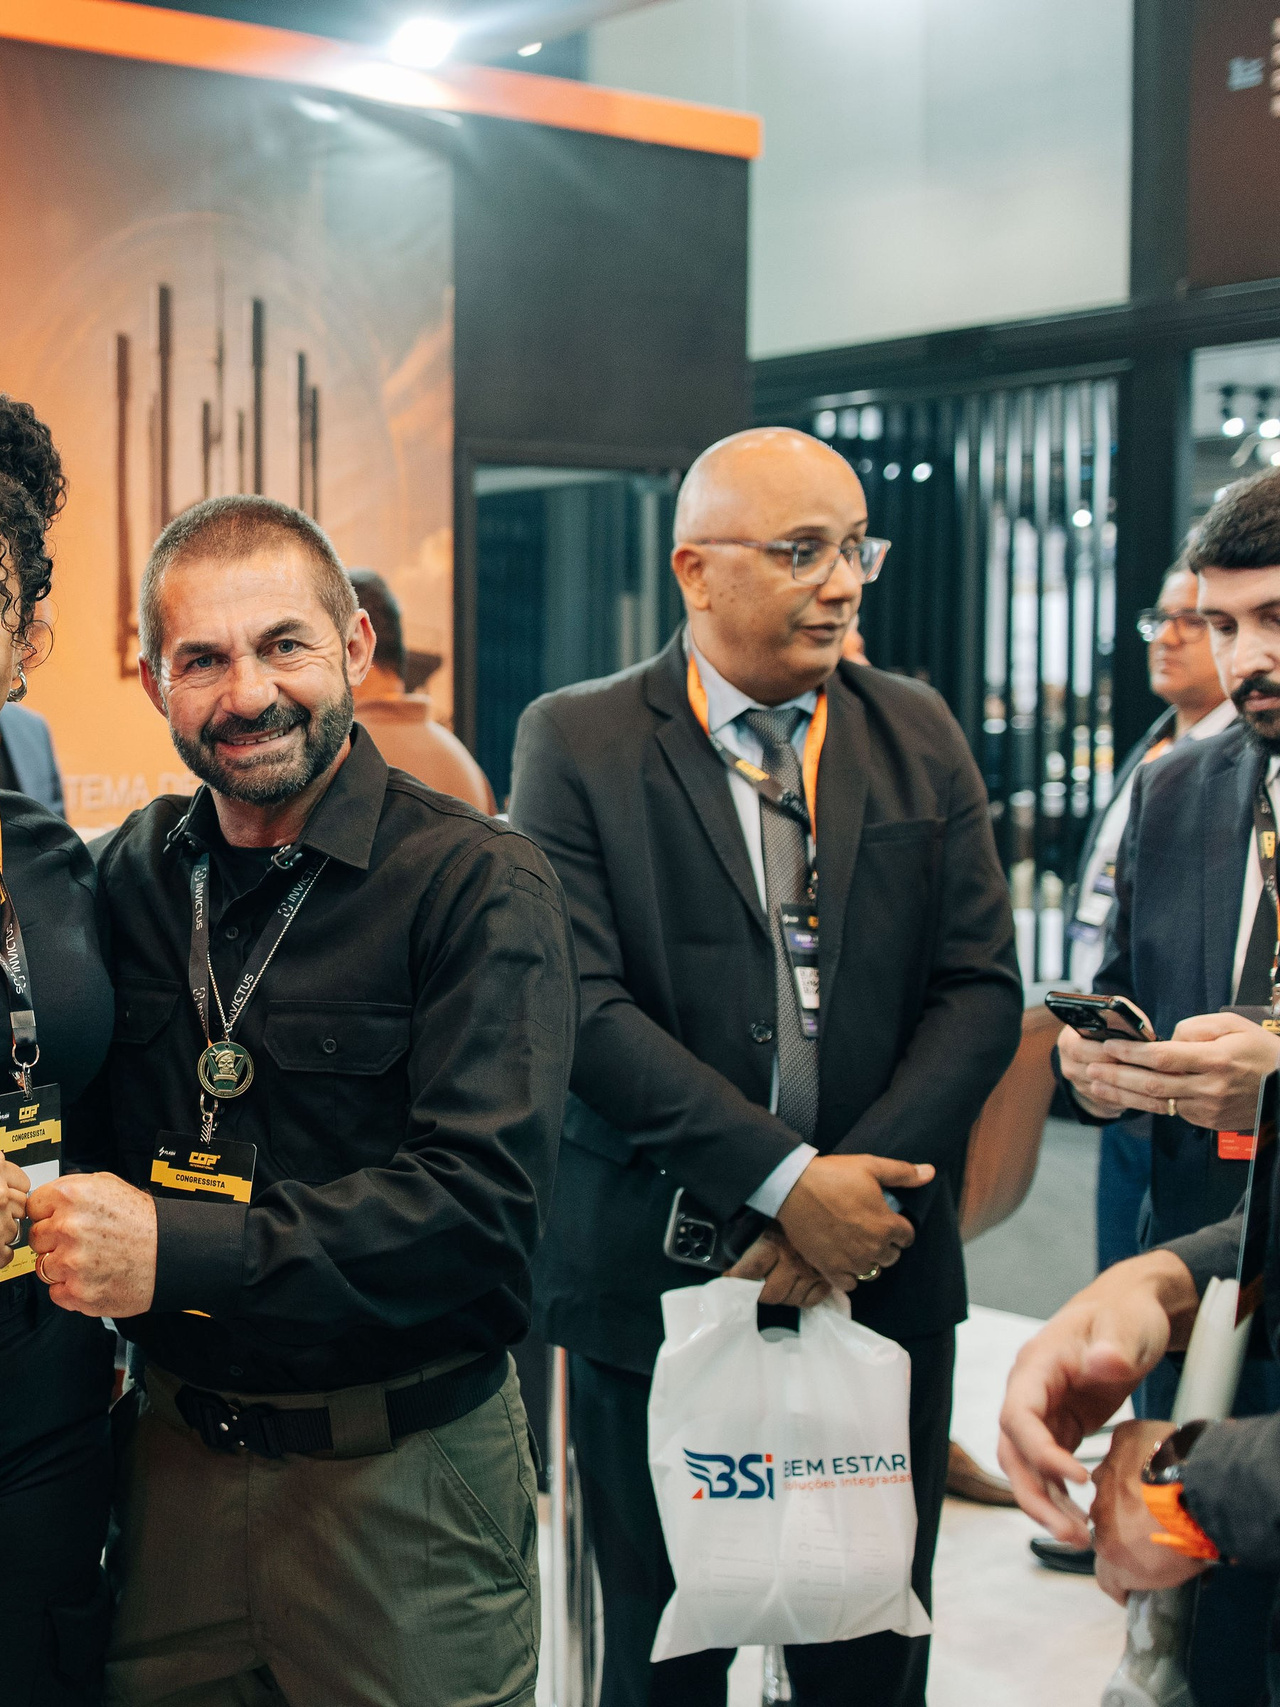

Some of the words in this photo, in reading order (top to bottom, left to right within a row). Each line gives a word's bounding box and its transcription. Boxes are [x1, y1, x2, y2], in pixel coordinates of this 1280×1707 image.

[62, 772, 151, 809] TEMA
[194, 882, 204, 932] INVICTUS
[4, 922, 22, 978] INVICTUS
[11, 1128, 46, 1143] CONGRESSISTA
[175, 1173, 226, 1189] CONGRESSISTA
[783, 1459, 826, 1478] BEM
[832, 1454, 908, 1475] ESTAR
